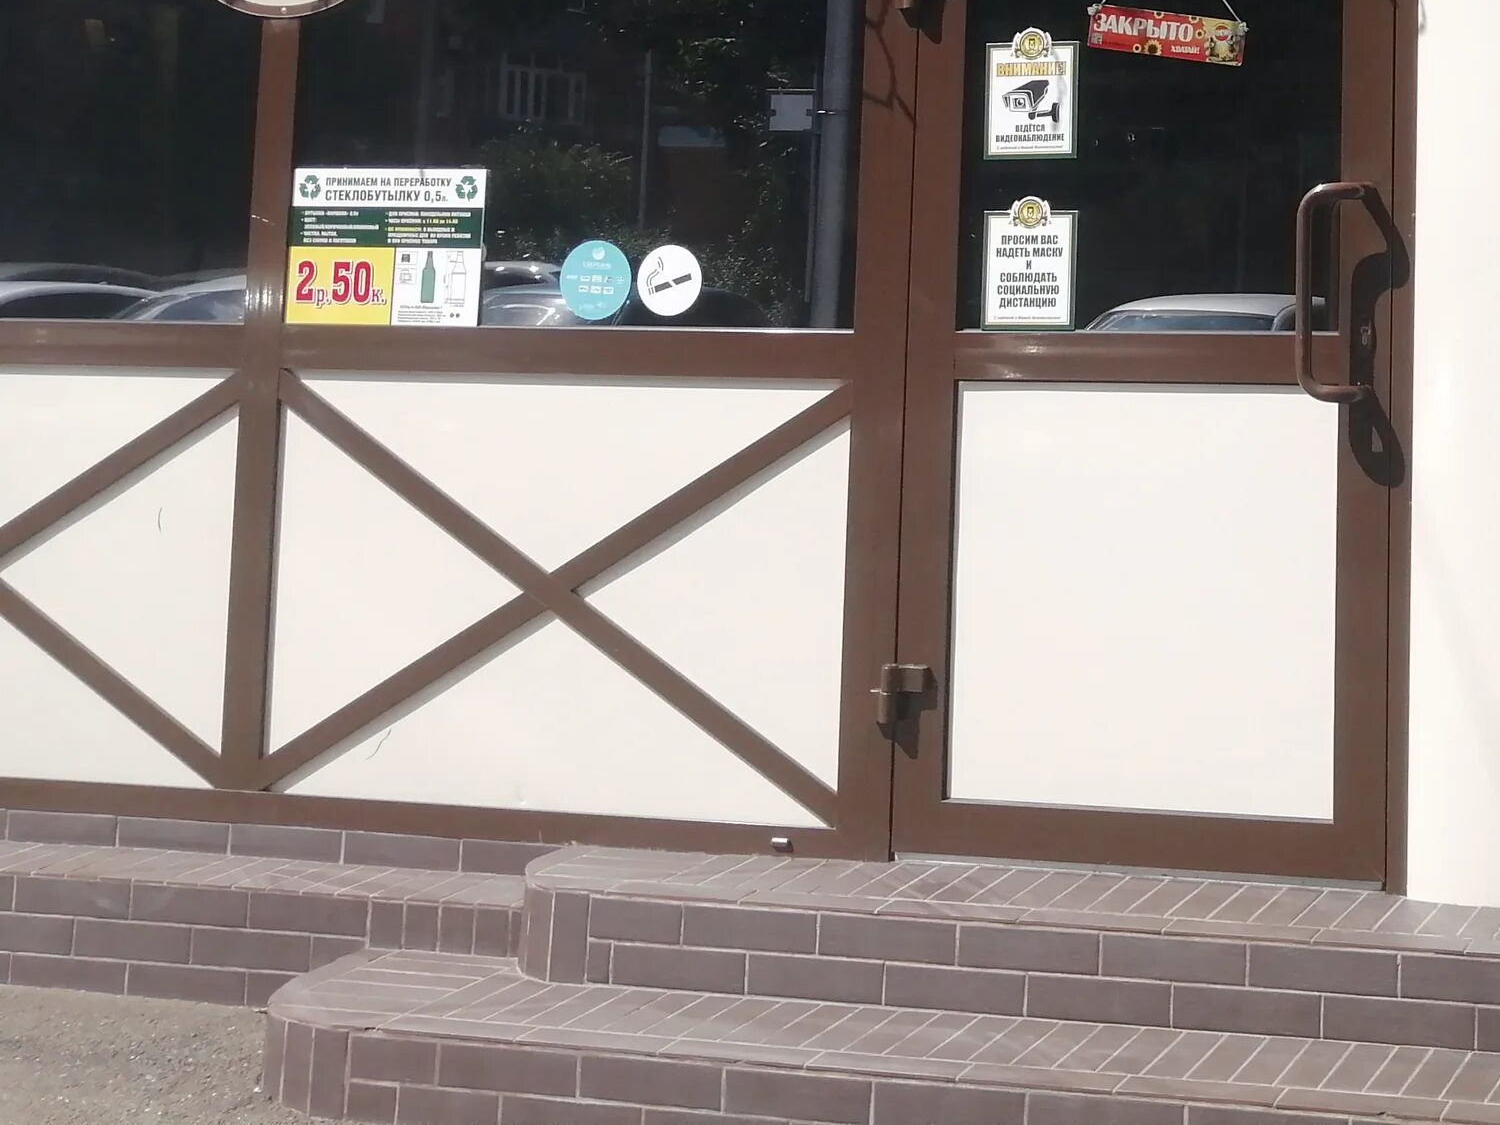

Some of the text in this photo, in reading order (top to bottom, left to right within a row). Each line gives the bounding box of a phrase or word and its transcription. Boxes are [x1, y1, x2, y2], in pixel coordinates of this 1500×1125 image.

[1094, 12, 1194, 43] ЗАКРЫТО
[996, 61, 1067, 77] ВНИМАНИЕ!
[995, 133, 1065, 143] ВИДЕОНАБЛЮДЕНИЕ
[325, 177, 452, 187] ПРИНИМАЕМ НА ПЕРЕРАБОТКУ
[325, 189, 421, 201] СТЕКЛОБУТЫЛКУ
[1001, 235, 1059, 245] ПРОСИМ ВАС
[996, 247, 1063, 259] НАДЕТЬ МАСКУ
[1026, 259, 1032, 270] И
[1000, 272, 1057, 284] СОБЛЮДАТЬ
[997, 285, 1060, 296] СОЦИАЛЬНУЮ
[999, 297, 1057, 309] ДИСТАНЦИЮ
